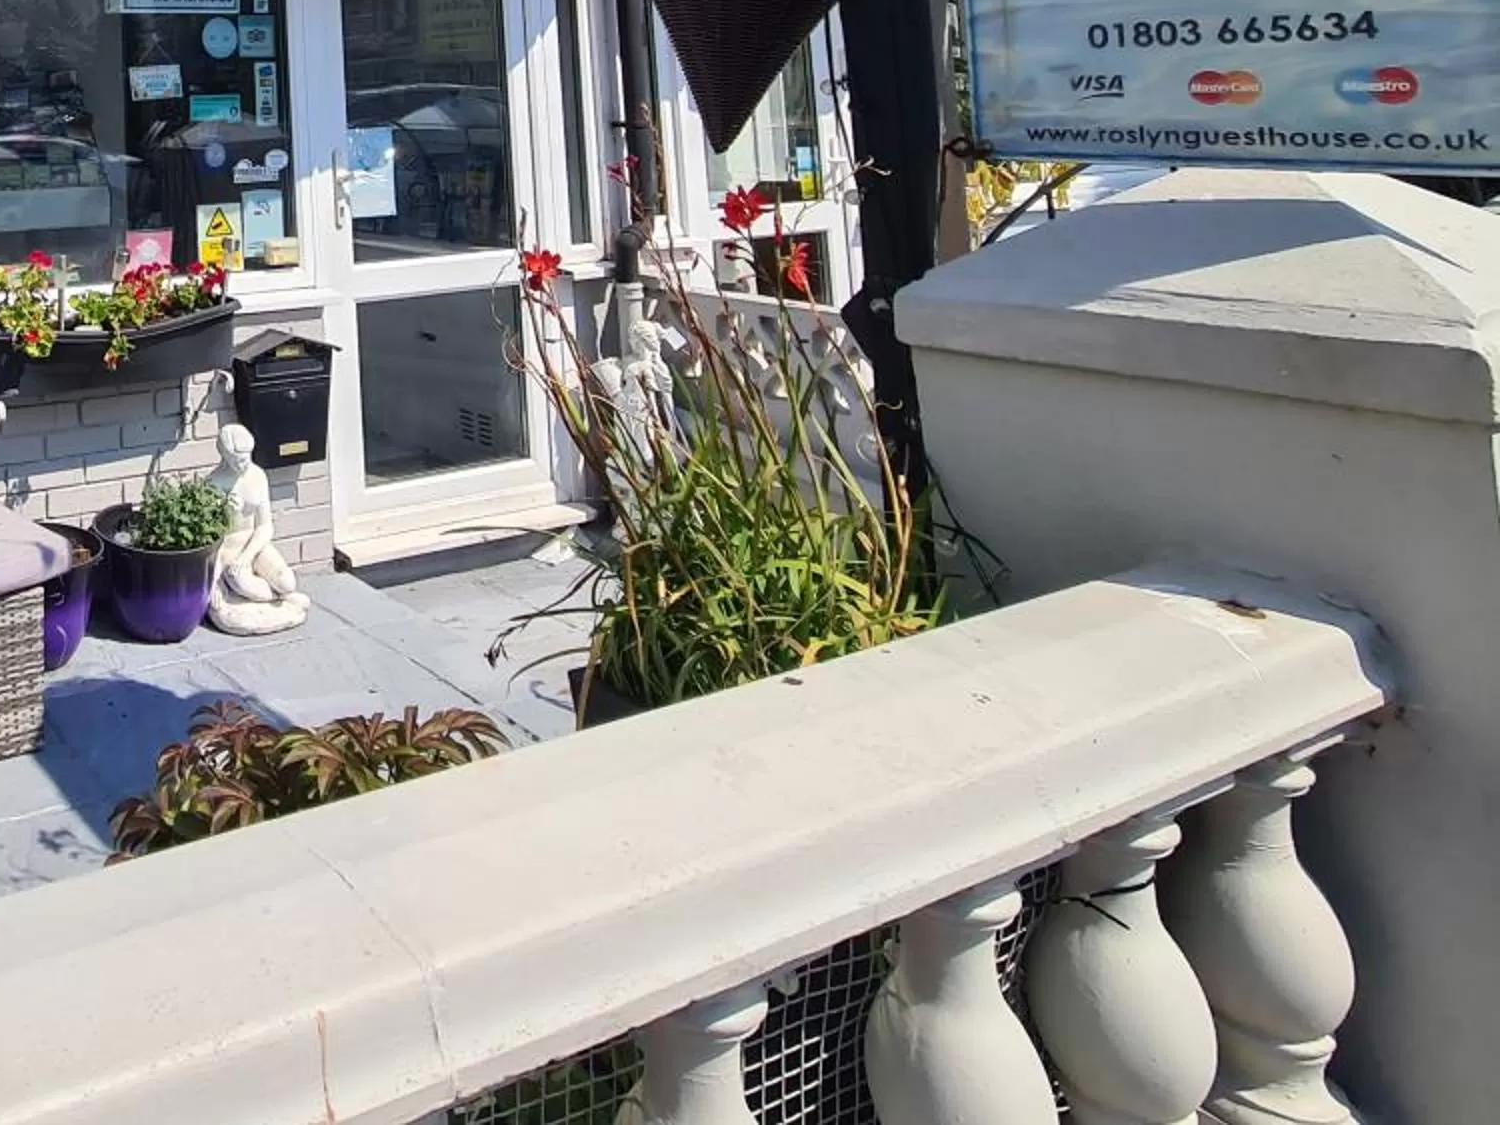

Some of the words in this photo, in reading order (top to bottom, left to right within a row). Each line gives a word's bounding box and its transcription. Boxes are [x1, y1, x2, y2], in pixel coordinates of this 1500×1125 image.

[1087, 19, 1201, 49] 01803
[1217, 10, 1379, 44] 665634
[1069, 74, 1125, 92] VISA
[1190, 82, 1260, 94] MasterCard
[1341, 79, 1412, 93] Maestro
[1025, 125, 1490, 152] www.roslynguesthouse.co.uk
